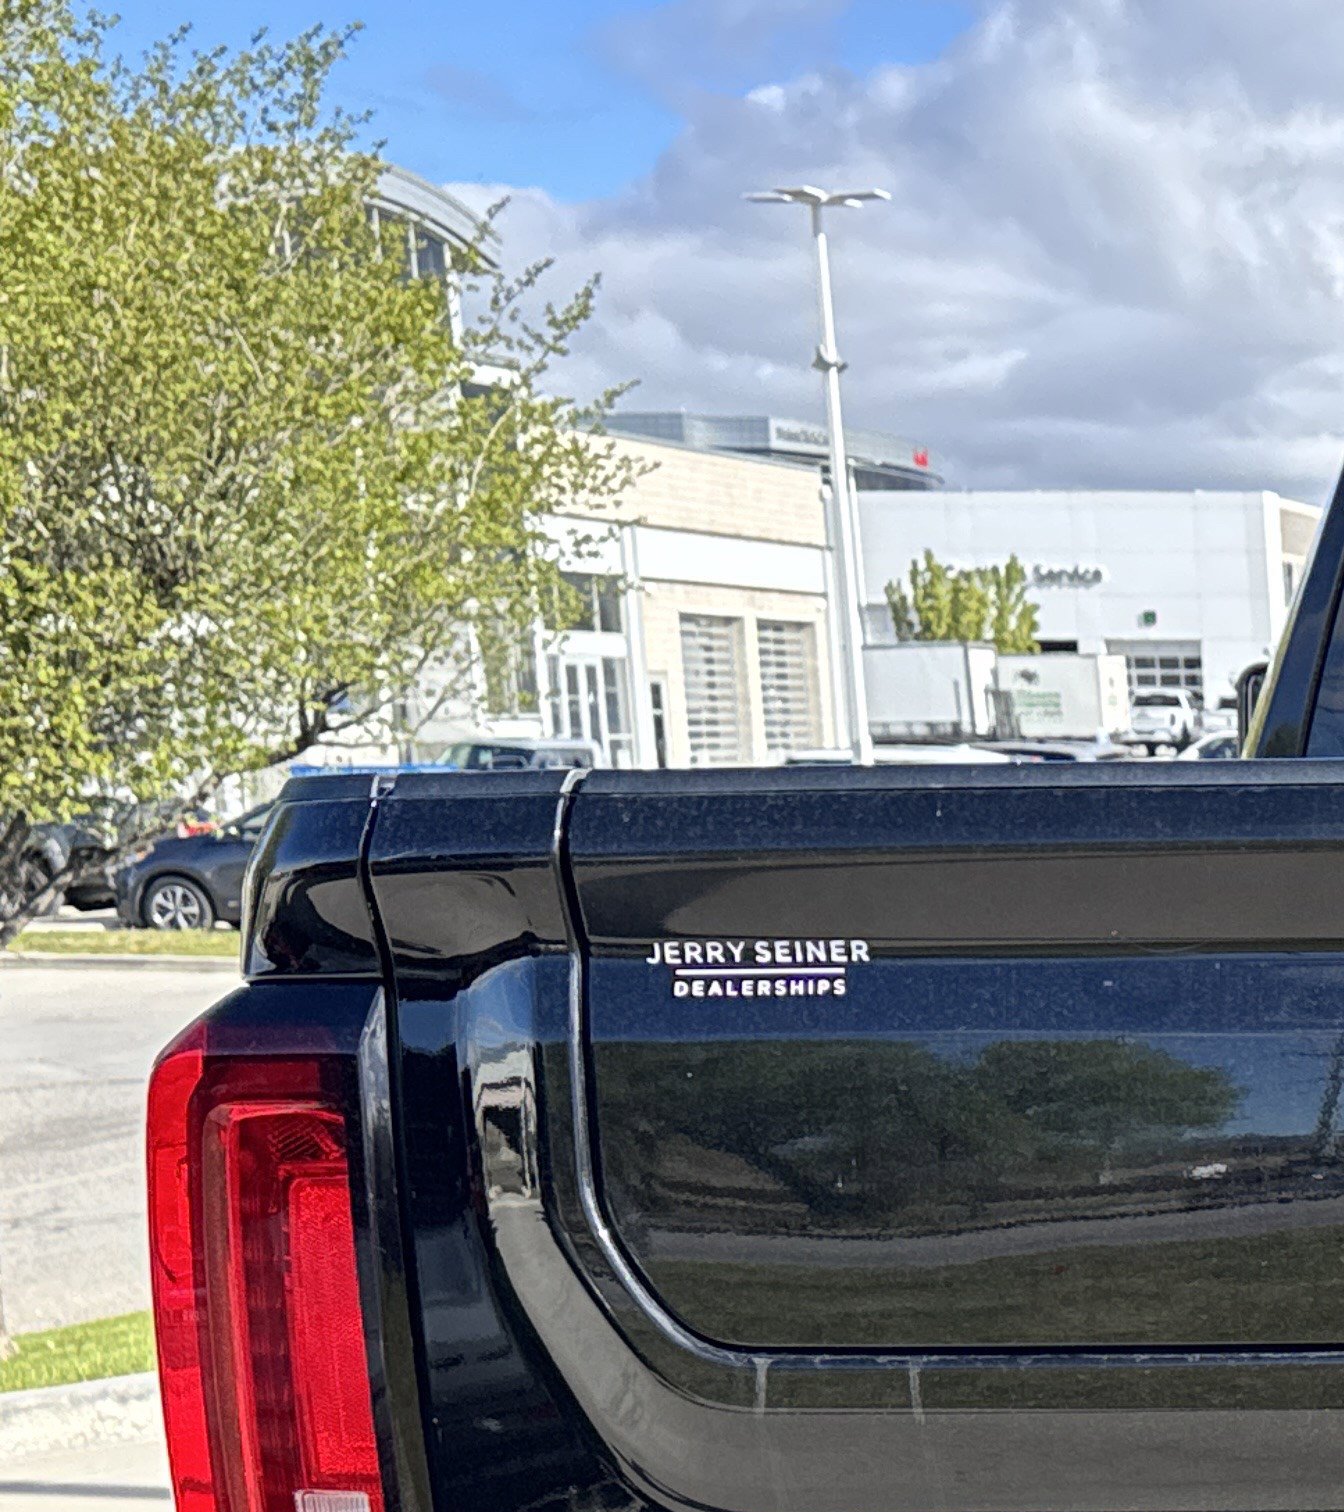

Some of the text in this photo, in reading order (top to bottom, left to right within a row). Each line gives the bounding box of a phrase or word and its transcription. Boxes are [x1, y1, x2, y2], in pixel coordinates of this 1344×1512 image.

[646, 939, 871, 965] JERRY SEINER
[673, 979, 846, 998] DEALERSHIPS
